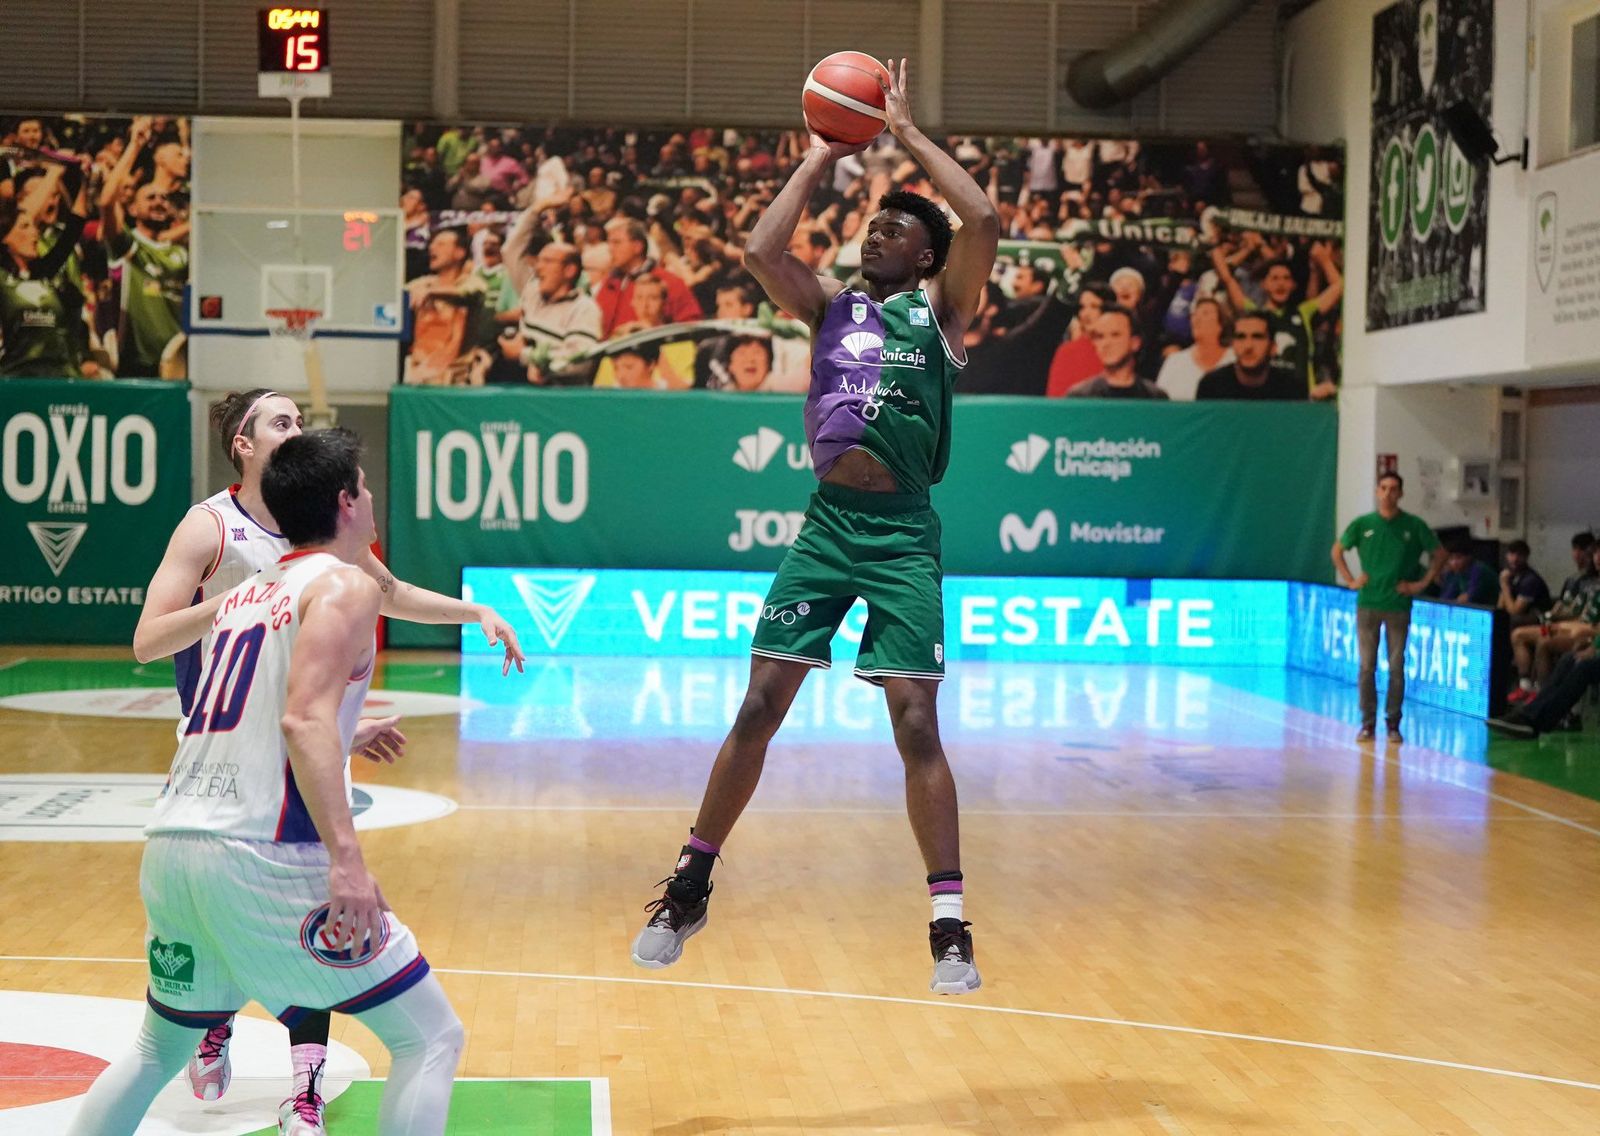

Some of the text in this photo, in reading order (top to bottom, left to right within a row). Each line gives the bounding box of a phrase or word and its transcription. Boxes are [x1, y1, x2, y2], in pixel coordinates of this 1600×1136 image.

[285, 34, 319, 70] 15
[879, 347, 926, 366] Unicaja
[1055, 436, 1161, 458] Fundación
[1055, 456, 1132, 482] Unicaja
[1070, 520, 1166, 544] Movistar
[67, 586, 144, 605] ESTATE
[960, 595, 1215, 648] ESTATE
[1407, 622, 1471, 691] STATE
[184, 621, 267, 737] 10
[184, 775, 238, 799] ZUBIA
